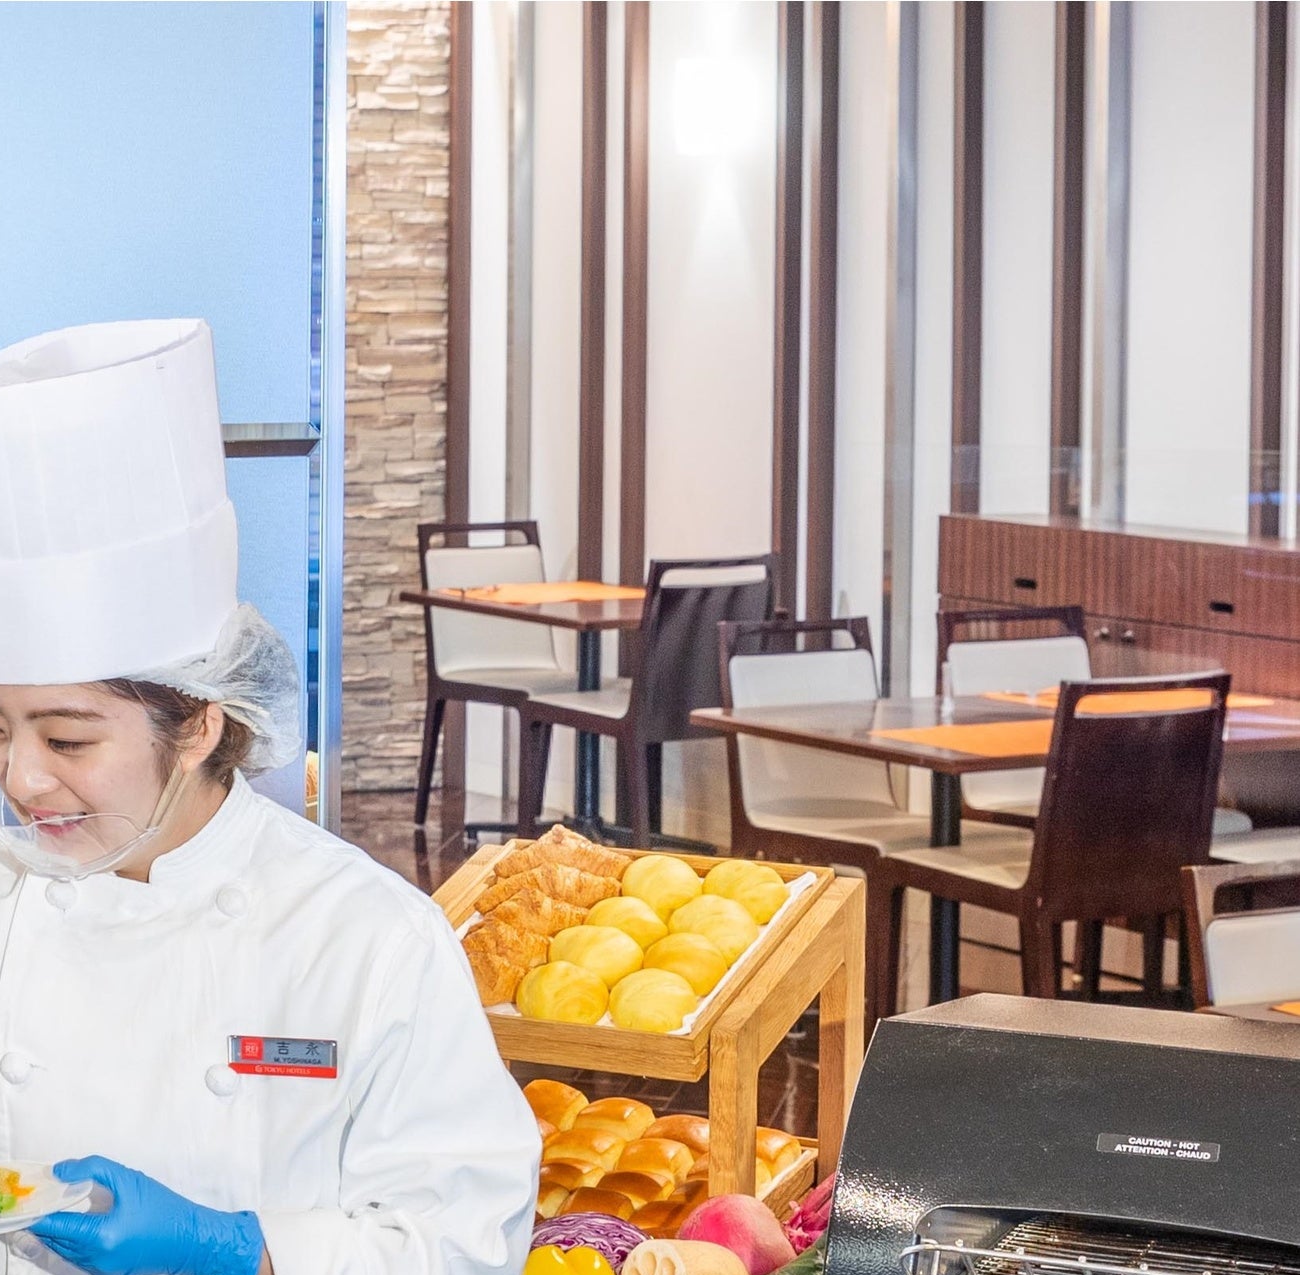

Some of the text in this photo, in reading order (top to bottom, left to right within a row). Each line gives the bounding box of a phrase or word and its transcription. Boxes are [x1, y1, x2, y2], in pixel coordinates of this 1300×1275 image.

[264, 1065, 311, 1075] TOKYU HOTELS
[1128, 1137, 1171, 1149] CAUTION
[1179, 1141, 1200, 1151] HOT
[1114, 1144, 1168, 1157] ATTENTION
[1176, 1150, 1211, 1160] CHAUD
